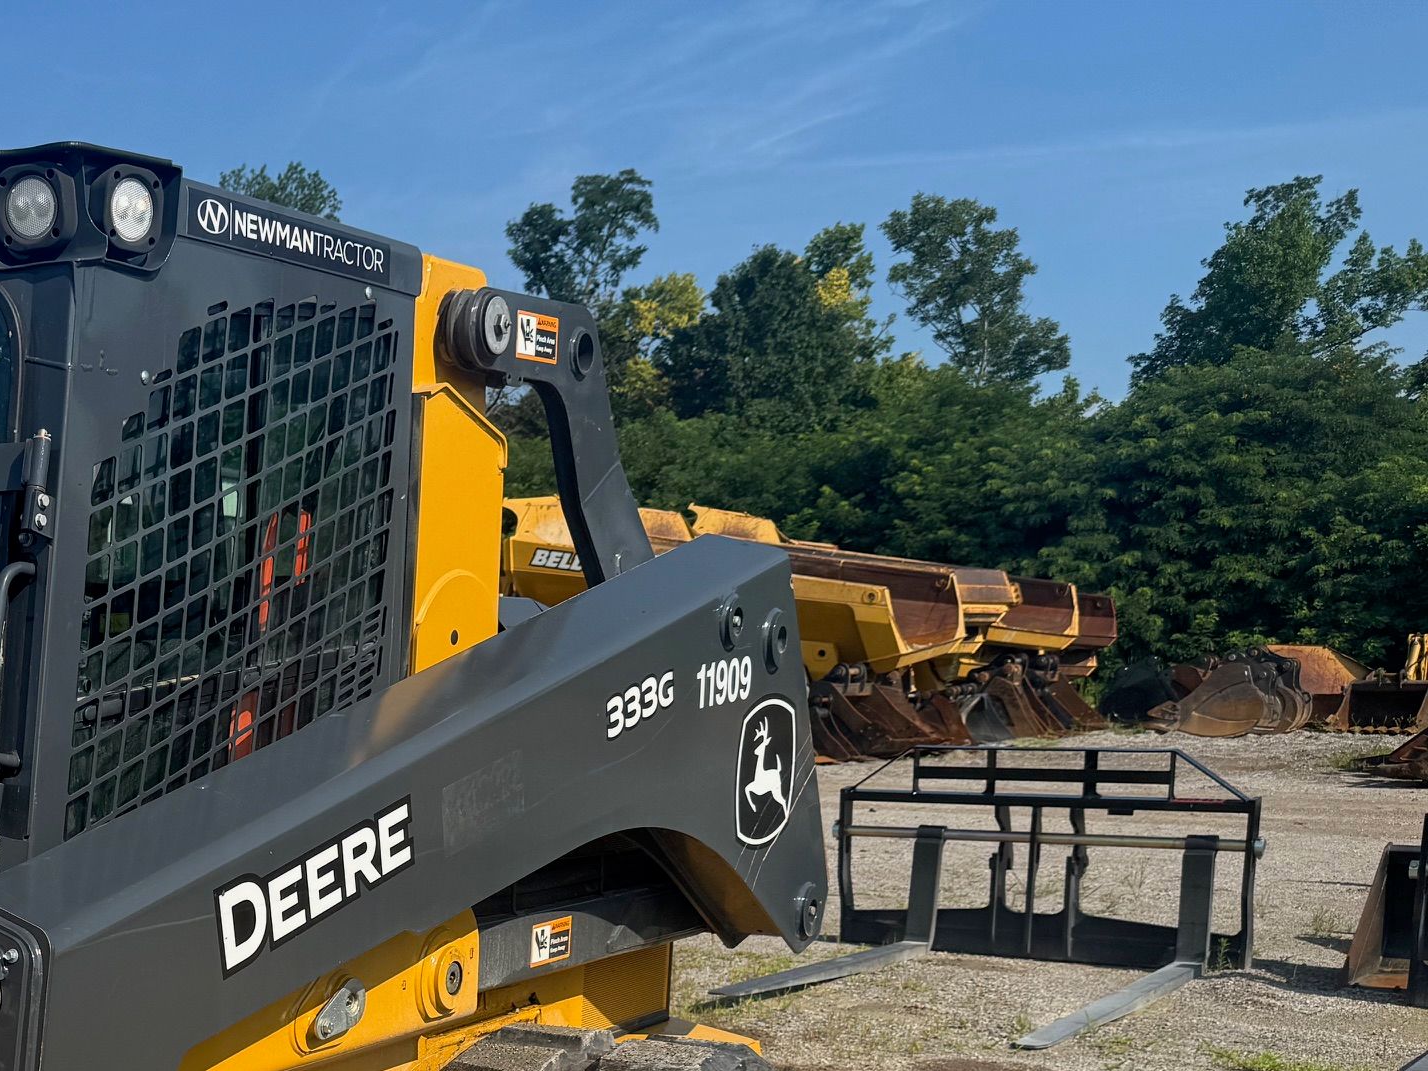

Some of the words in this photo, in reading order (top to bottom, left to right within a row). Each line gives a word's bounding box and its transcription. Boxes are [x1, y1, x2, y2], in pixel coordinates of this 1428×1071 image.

[606, 671, 674, 738] 333G
[697, 656, 752, 709] 11909
[218, 803, 412, 970] DEERE
